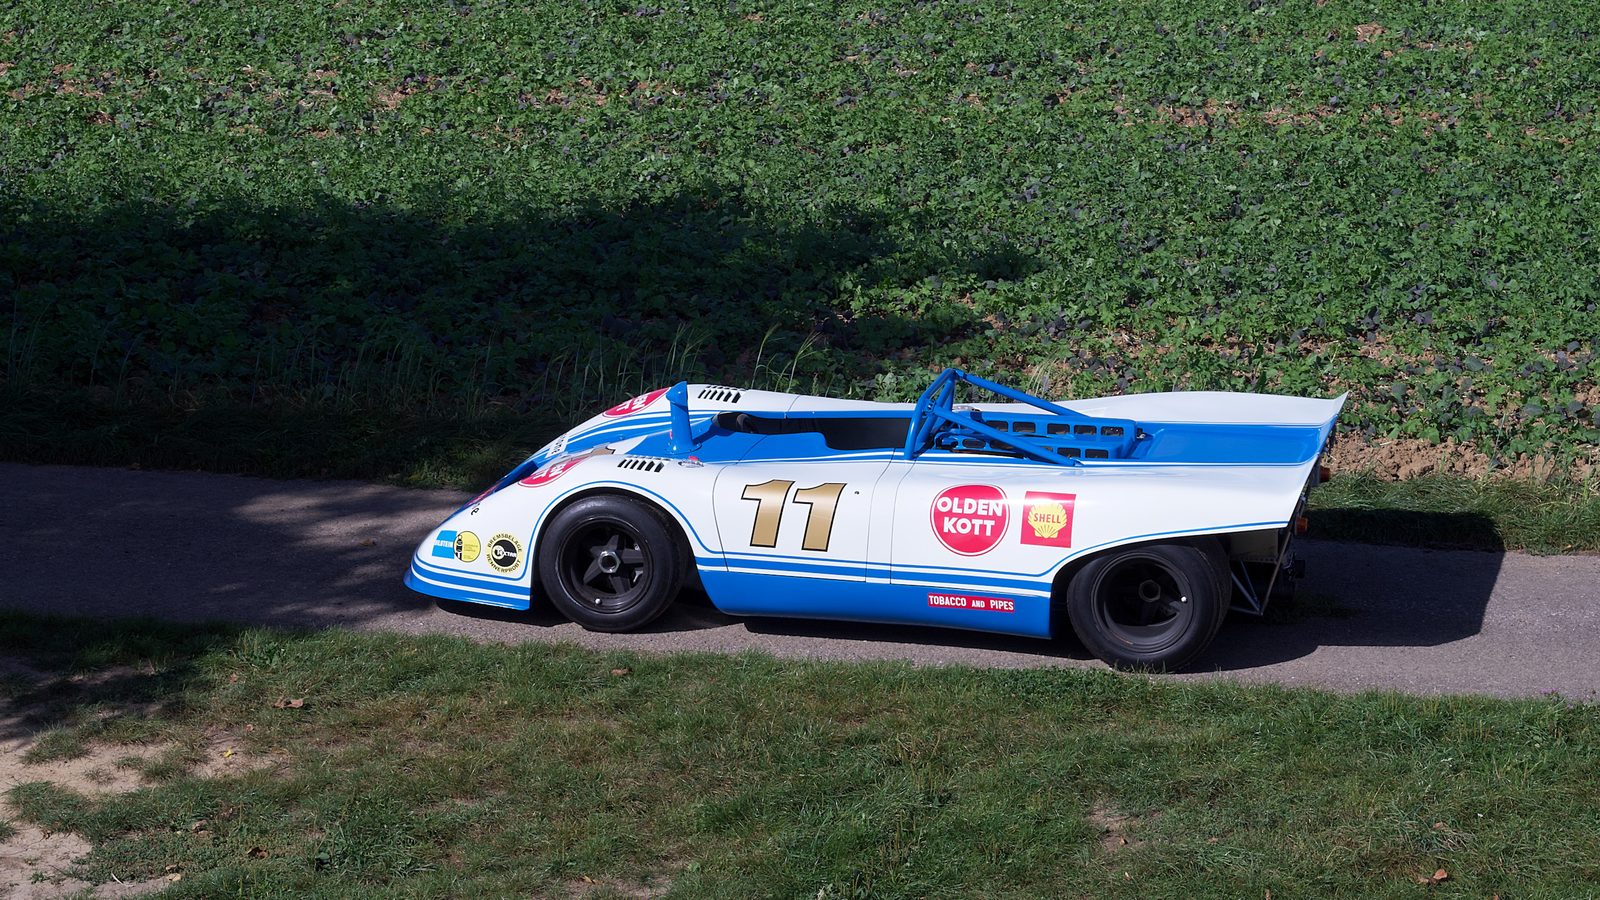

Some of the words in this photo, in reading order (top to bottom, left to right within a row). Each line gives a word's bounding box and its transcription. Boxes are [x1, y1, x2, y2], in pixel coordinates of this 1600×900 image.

[740, 479, 848, 553] 11
[936, 496, 1004, 517] OLDEN
[943, 516, 996, 537] KOTT
[1033, 512, 1062, 524] SHELL
[928, 595, 967, 607] TOBACCO
[971, 599, 985, 608] AND
[990, 599, 1014, 611] PIPES
